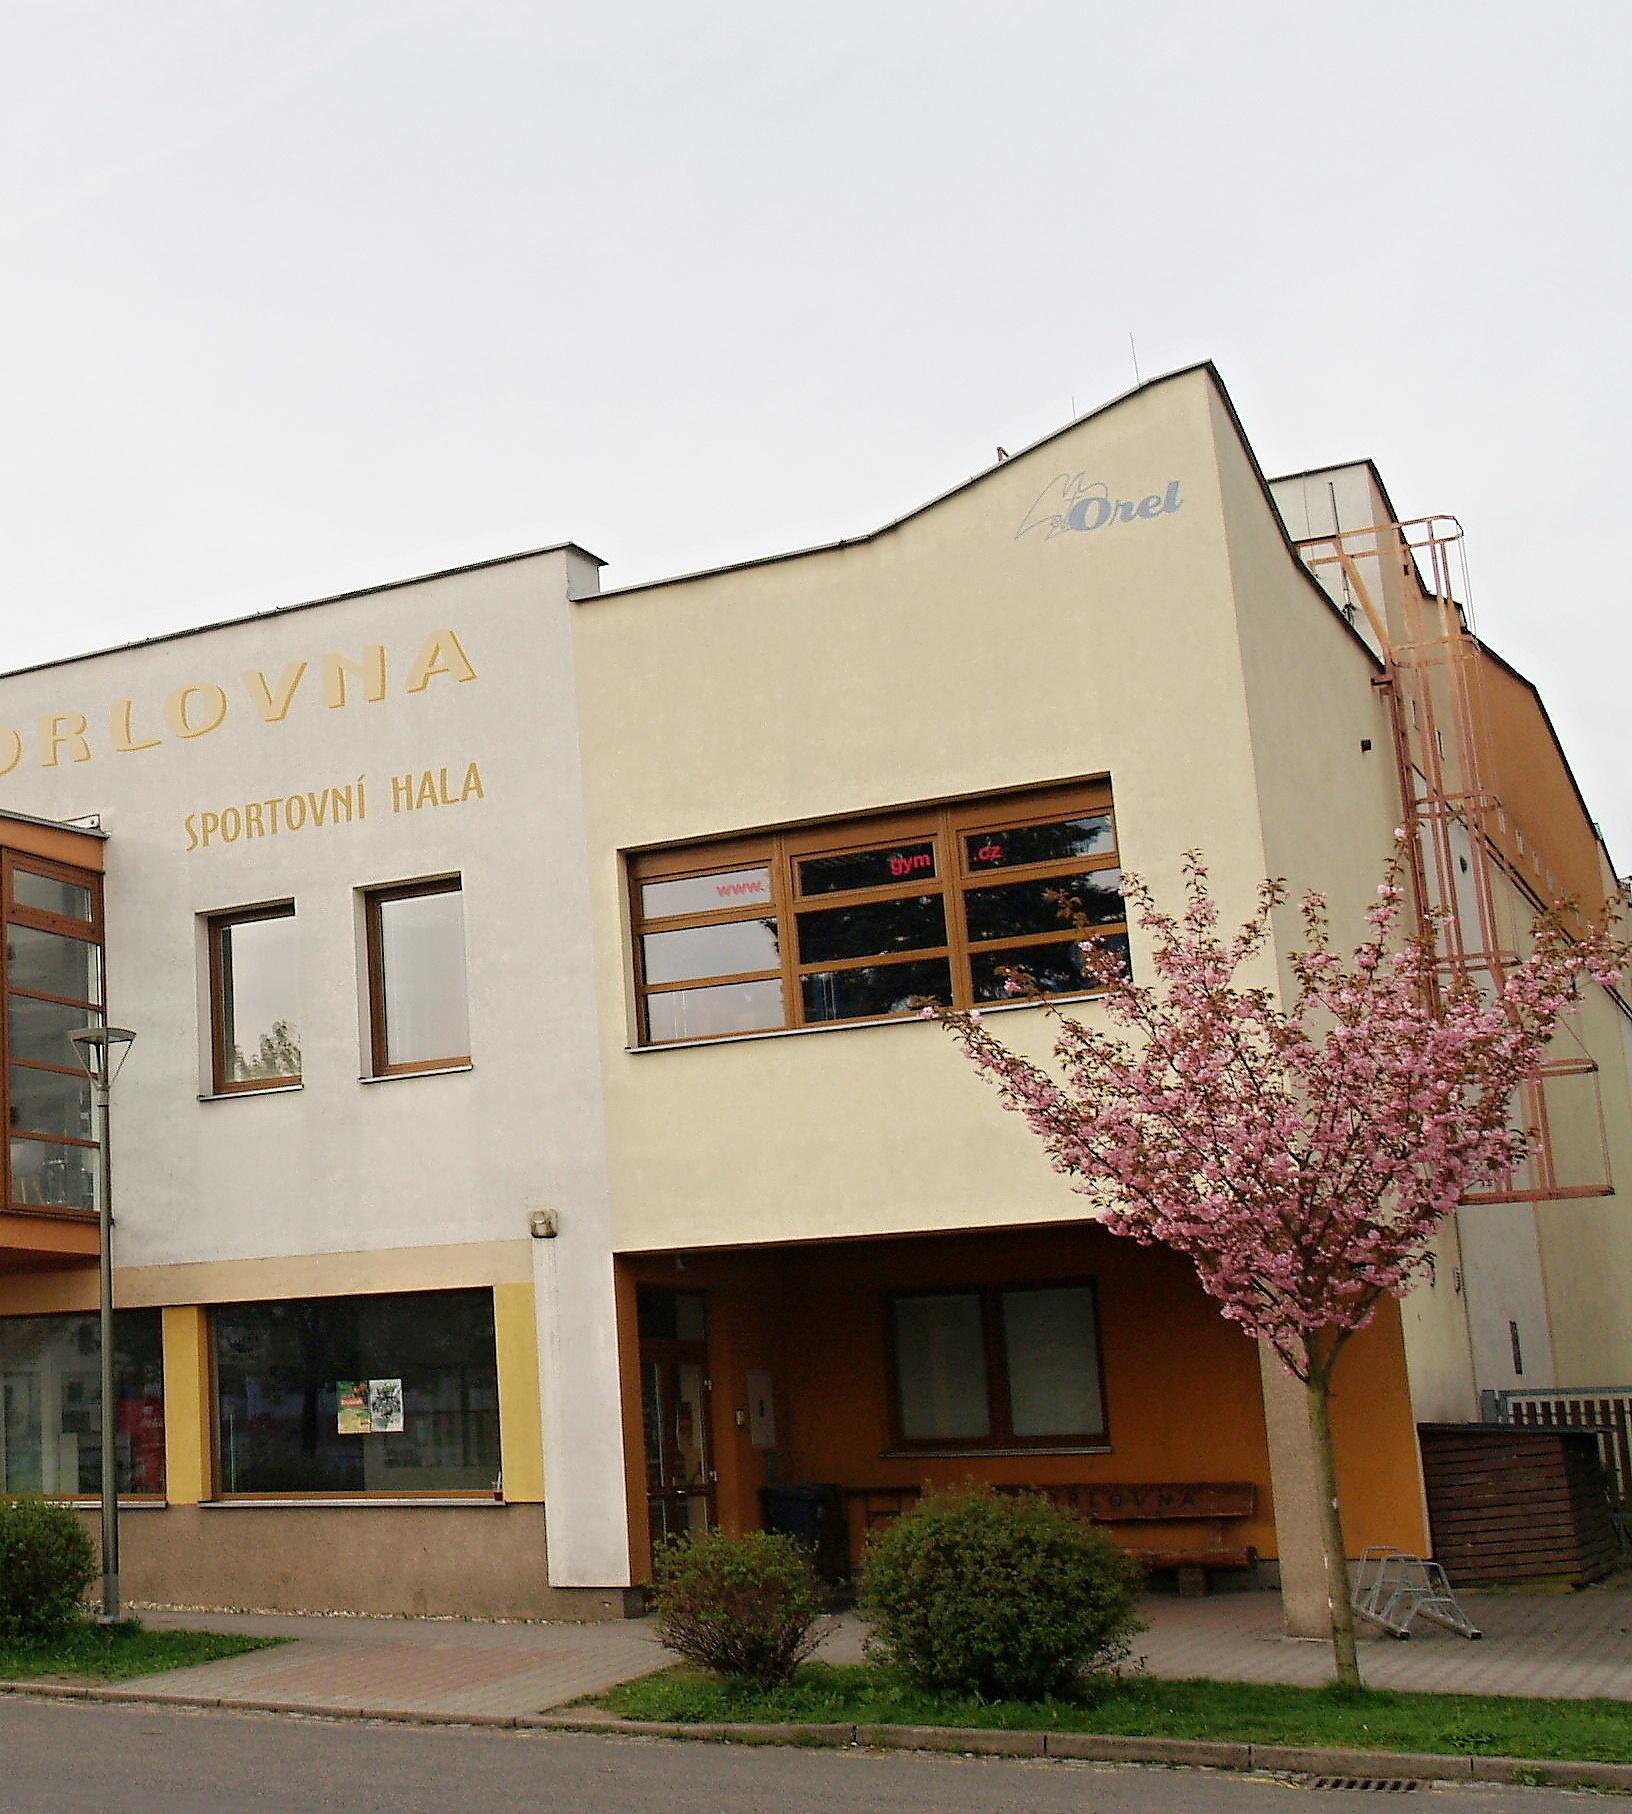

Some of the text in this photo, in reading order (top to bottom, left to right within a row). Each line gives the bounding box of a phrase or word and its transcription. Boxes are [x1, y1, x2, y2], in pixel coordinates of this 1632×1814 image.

[1067, 480, 1184, 531] Orel
[184, 762, 485, 851] SPORTOVNÍ HALA
[889, 852, 932, 876] gym
[1048, 1489, 1194, 1509] RLOVNA
